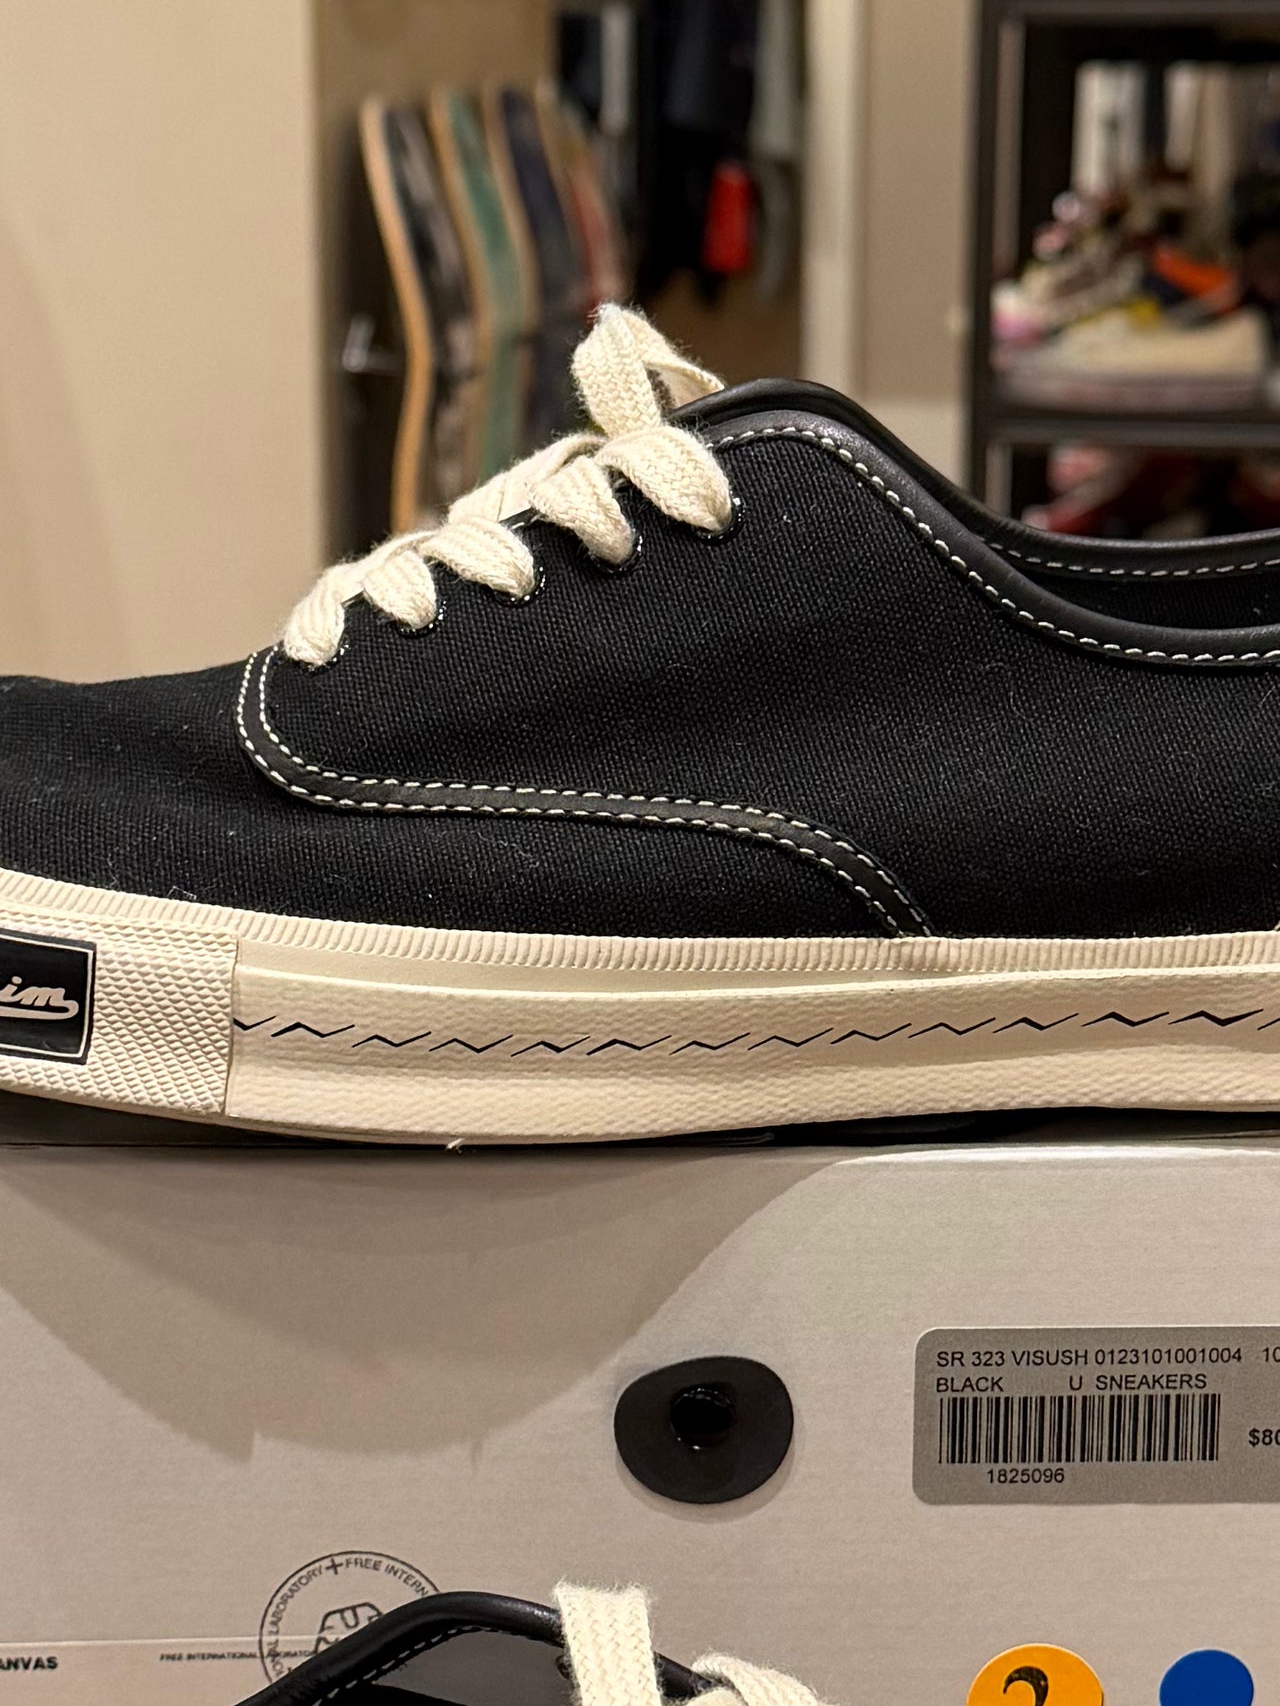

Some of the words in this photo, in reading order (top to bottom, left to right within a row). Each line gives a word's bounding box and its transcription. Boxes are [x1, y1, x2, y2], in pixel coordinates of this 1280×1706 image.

[935, 1351, 966, 1368] SR
[971, 1351, 1006, 1367] 323
[1011, 1349, 1089, 1367] VISUSH
[1094, 1346, 1242, 1365] 0123101001004
[935, 1376, 1005, 1393] BLACK
[1068, 1374, 1084, 1391] U
[1096, 1373, 1208, 1391] SNEAKERS
[986, 1468, 1066, 1485] 1825096
